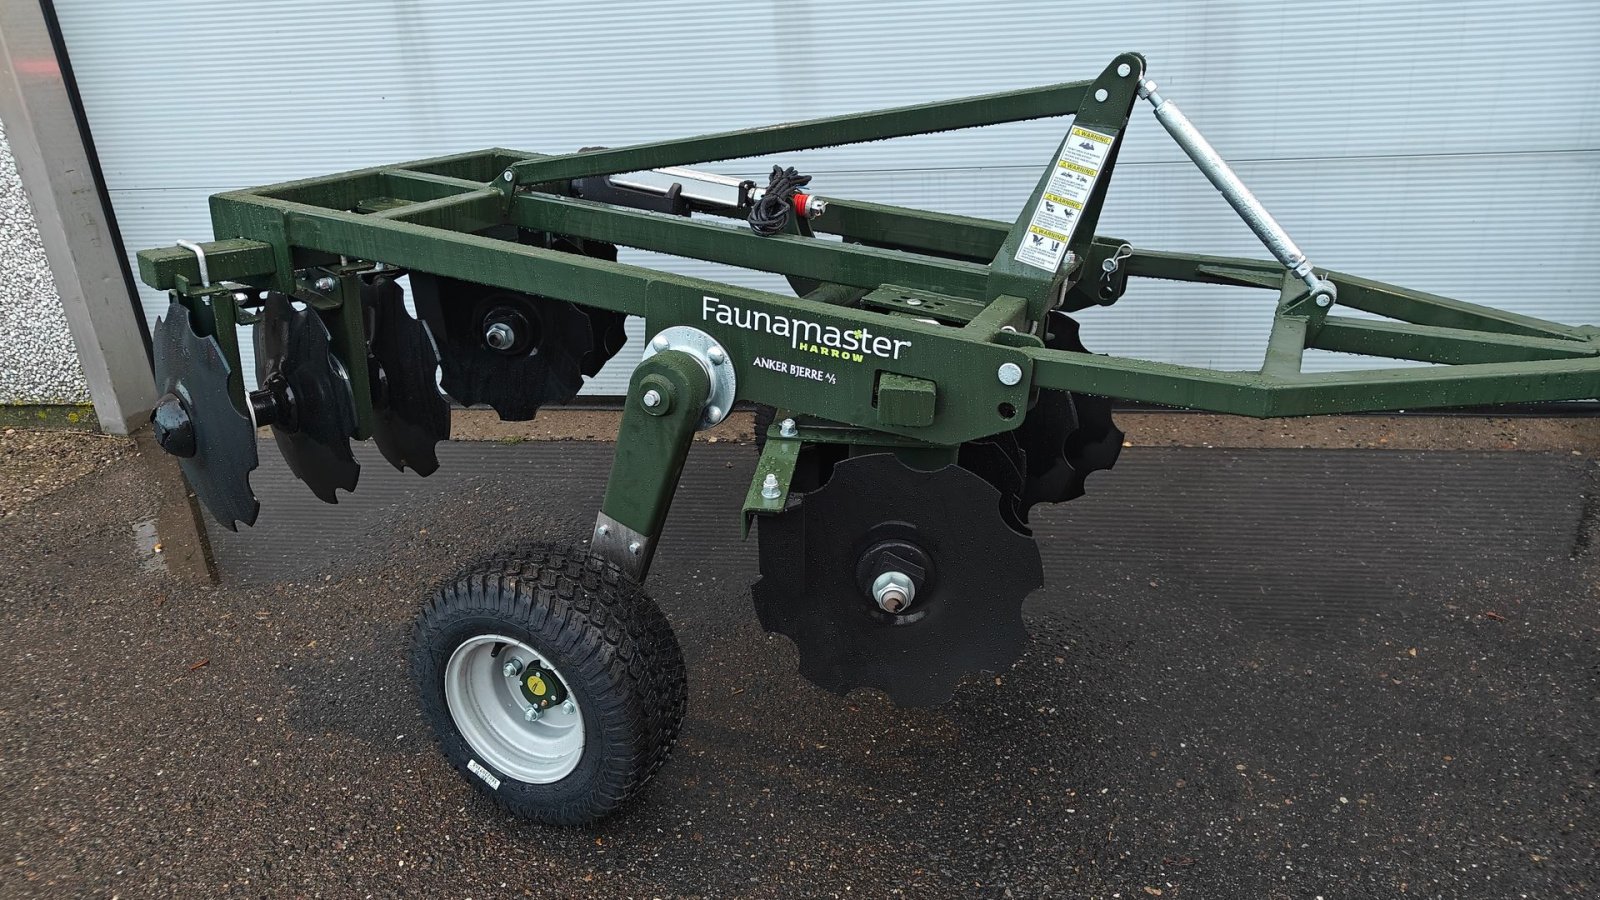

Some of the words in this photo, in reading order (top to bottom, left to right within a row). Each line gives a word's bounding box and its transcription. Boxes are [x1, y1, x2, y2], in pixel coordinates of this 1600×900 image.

[1081, 131, 1109, 143] WARNING
[1067, 162, 1095, 176] WARNING
[1052, 196, 1080, 208] WARNING
[1038, 229, 1066, 241] WARNING
[702, 295, 912, 360] Faunamaster
[799, 342, 864, 363] HARROW
[753, 356, 788, 374] ANKER
[789, 364, 824, 381] BJERRE
